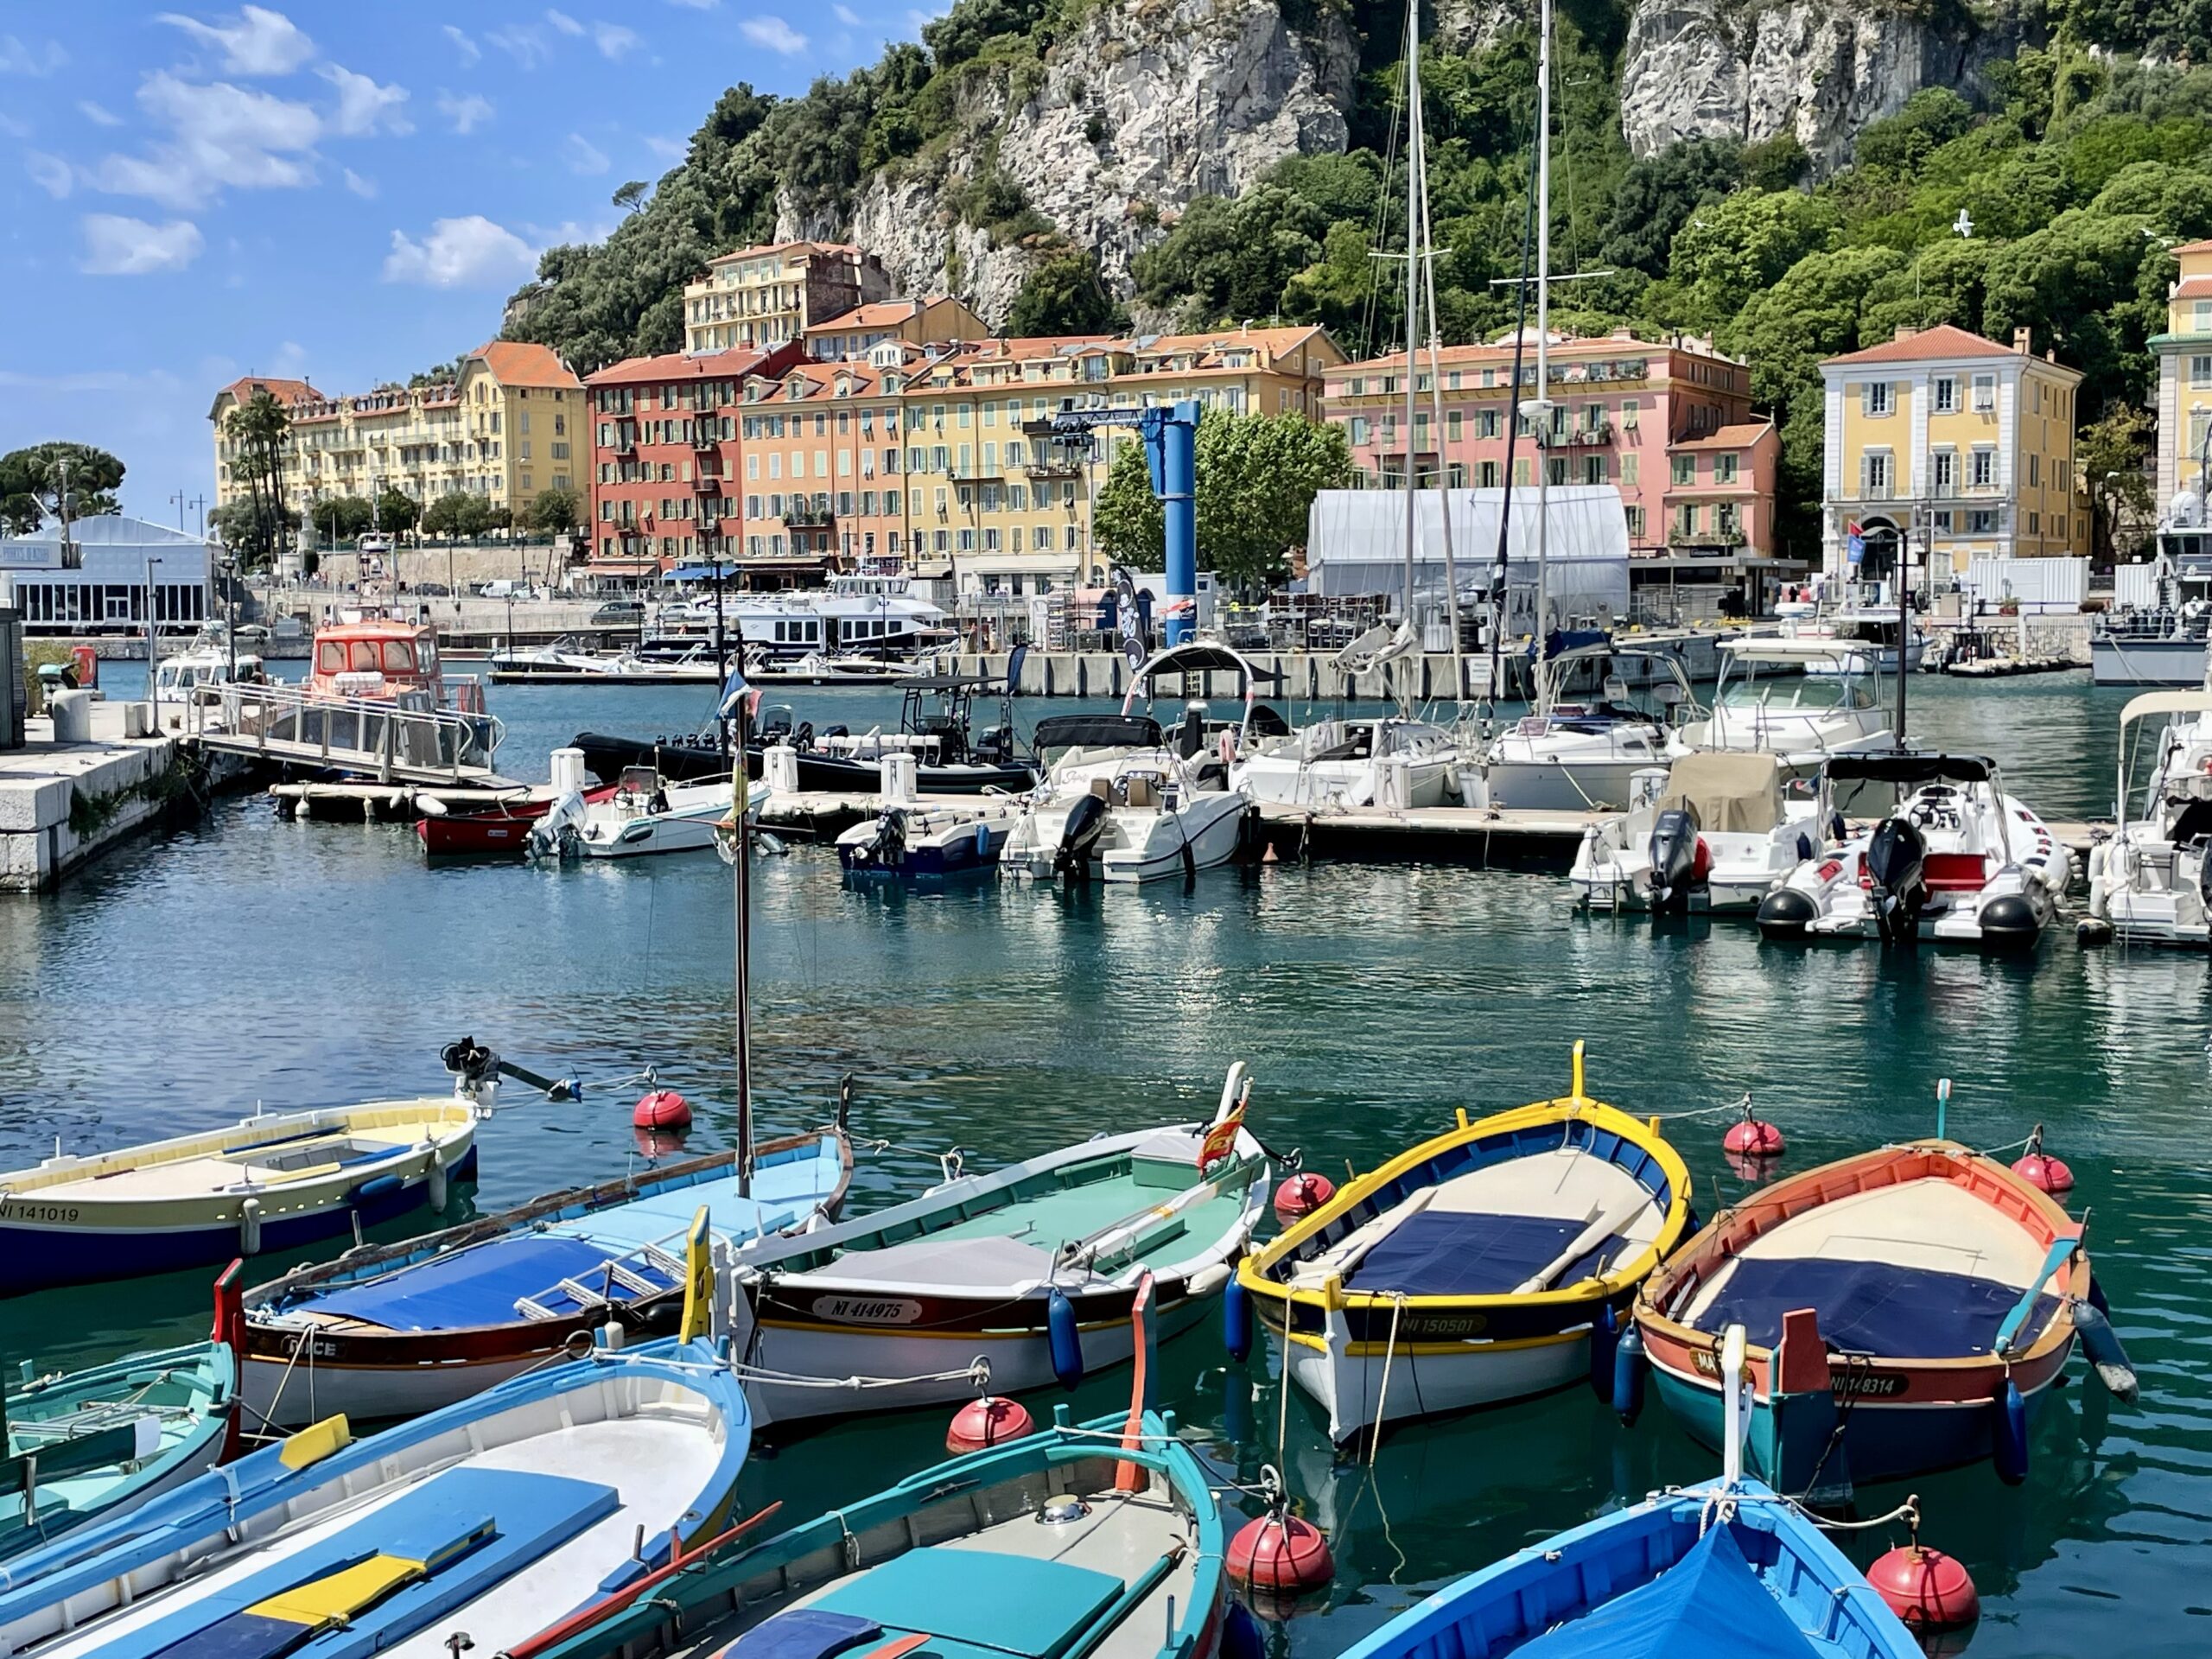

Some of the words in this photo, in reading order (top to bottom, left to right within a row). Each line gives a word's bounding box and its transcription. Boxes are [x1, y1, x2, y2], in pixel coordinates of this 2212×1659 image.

[18, 1205, 79, 1223] 141019
[830, 1300, 849, 1315] NI
[850, 1301, 902, 1318] 414975
[1422, 1319, 1474, 1332] 150501
